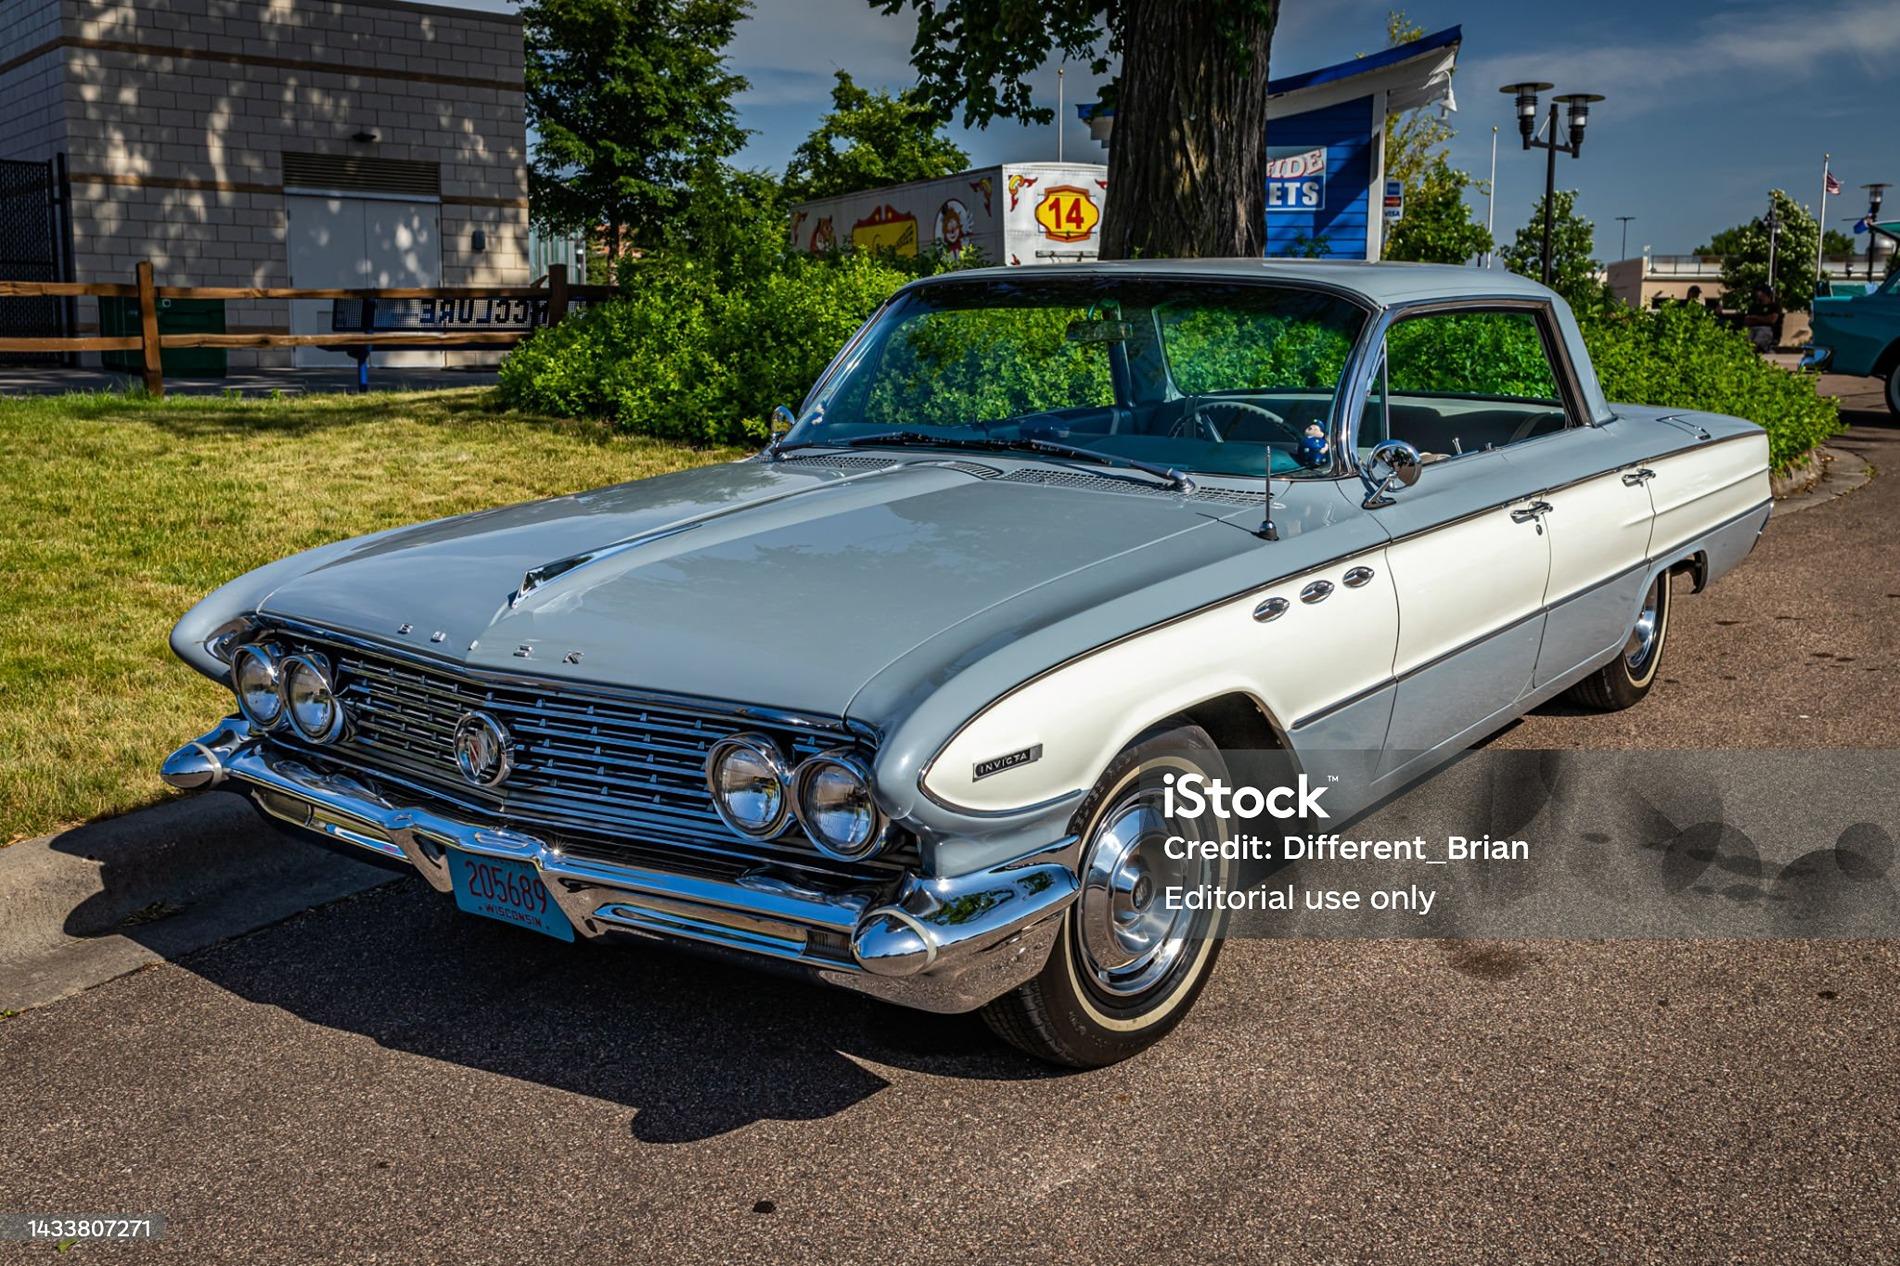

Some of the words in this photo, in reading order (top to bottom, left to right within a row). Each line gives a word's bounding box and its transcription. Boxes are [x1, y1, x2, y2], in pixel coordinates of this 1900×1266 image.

[1048, 197, 1085, 229] 14
[979, 752, 1028, 774] INVICTA
[465, 860, 548, 915] 205689
[485, 903, 543, 929] WISCONSIN
